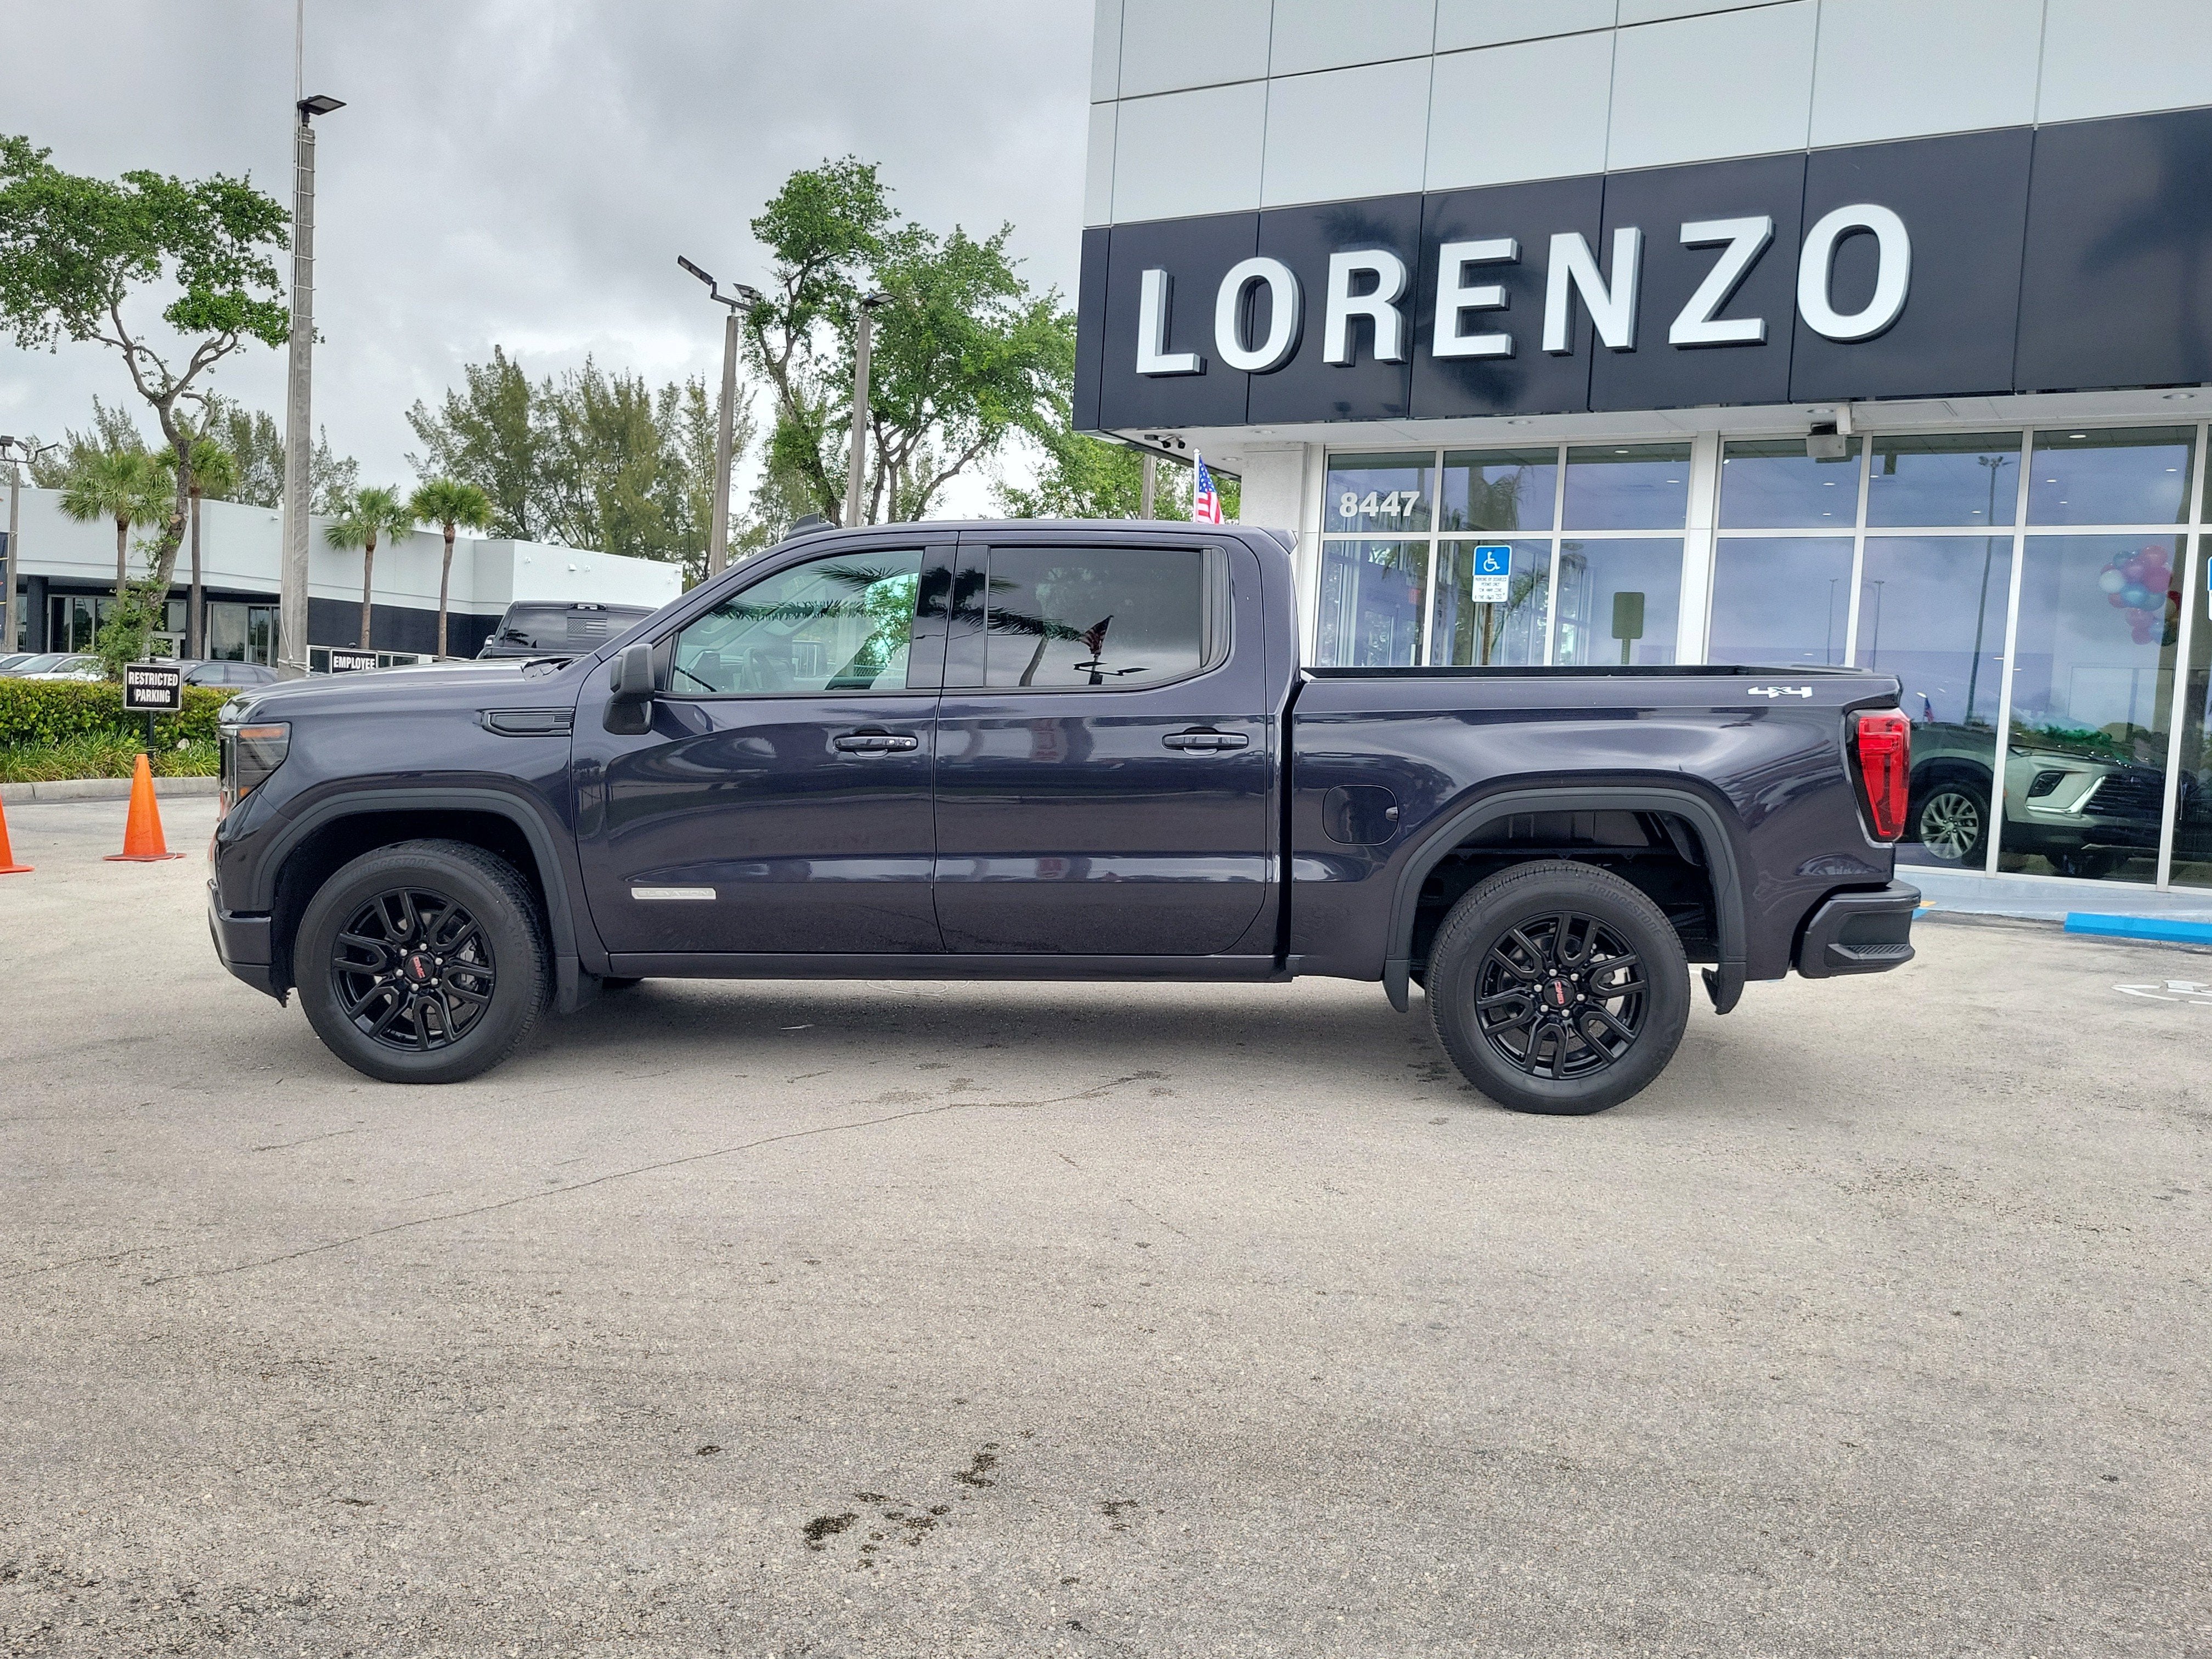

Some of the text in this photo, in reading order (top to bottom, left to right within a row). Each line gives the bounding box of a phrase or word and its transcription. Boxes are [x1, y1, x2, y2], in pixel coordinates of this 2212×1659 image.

[1136, 203, 1911, 376] LORENZO
[1339, 490, 1420, 517] 8447
[333, 656, 375, 670] EMPLOYEE
[128, 672, 178, 686] RESTRICTED
[135, 689, 171, 703] PARKING
